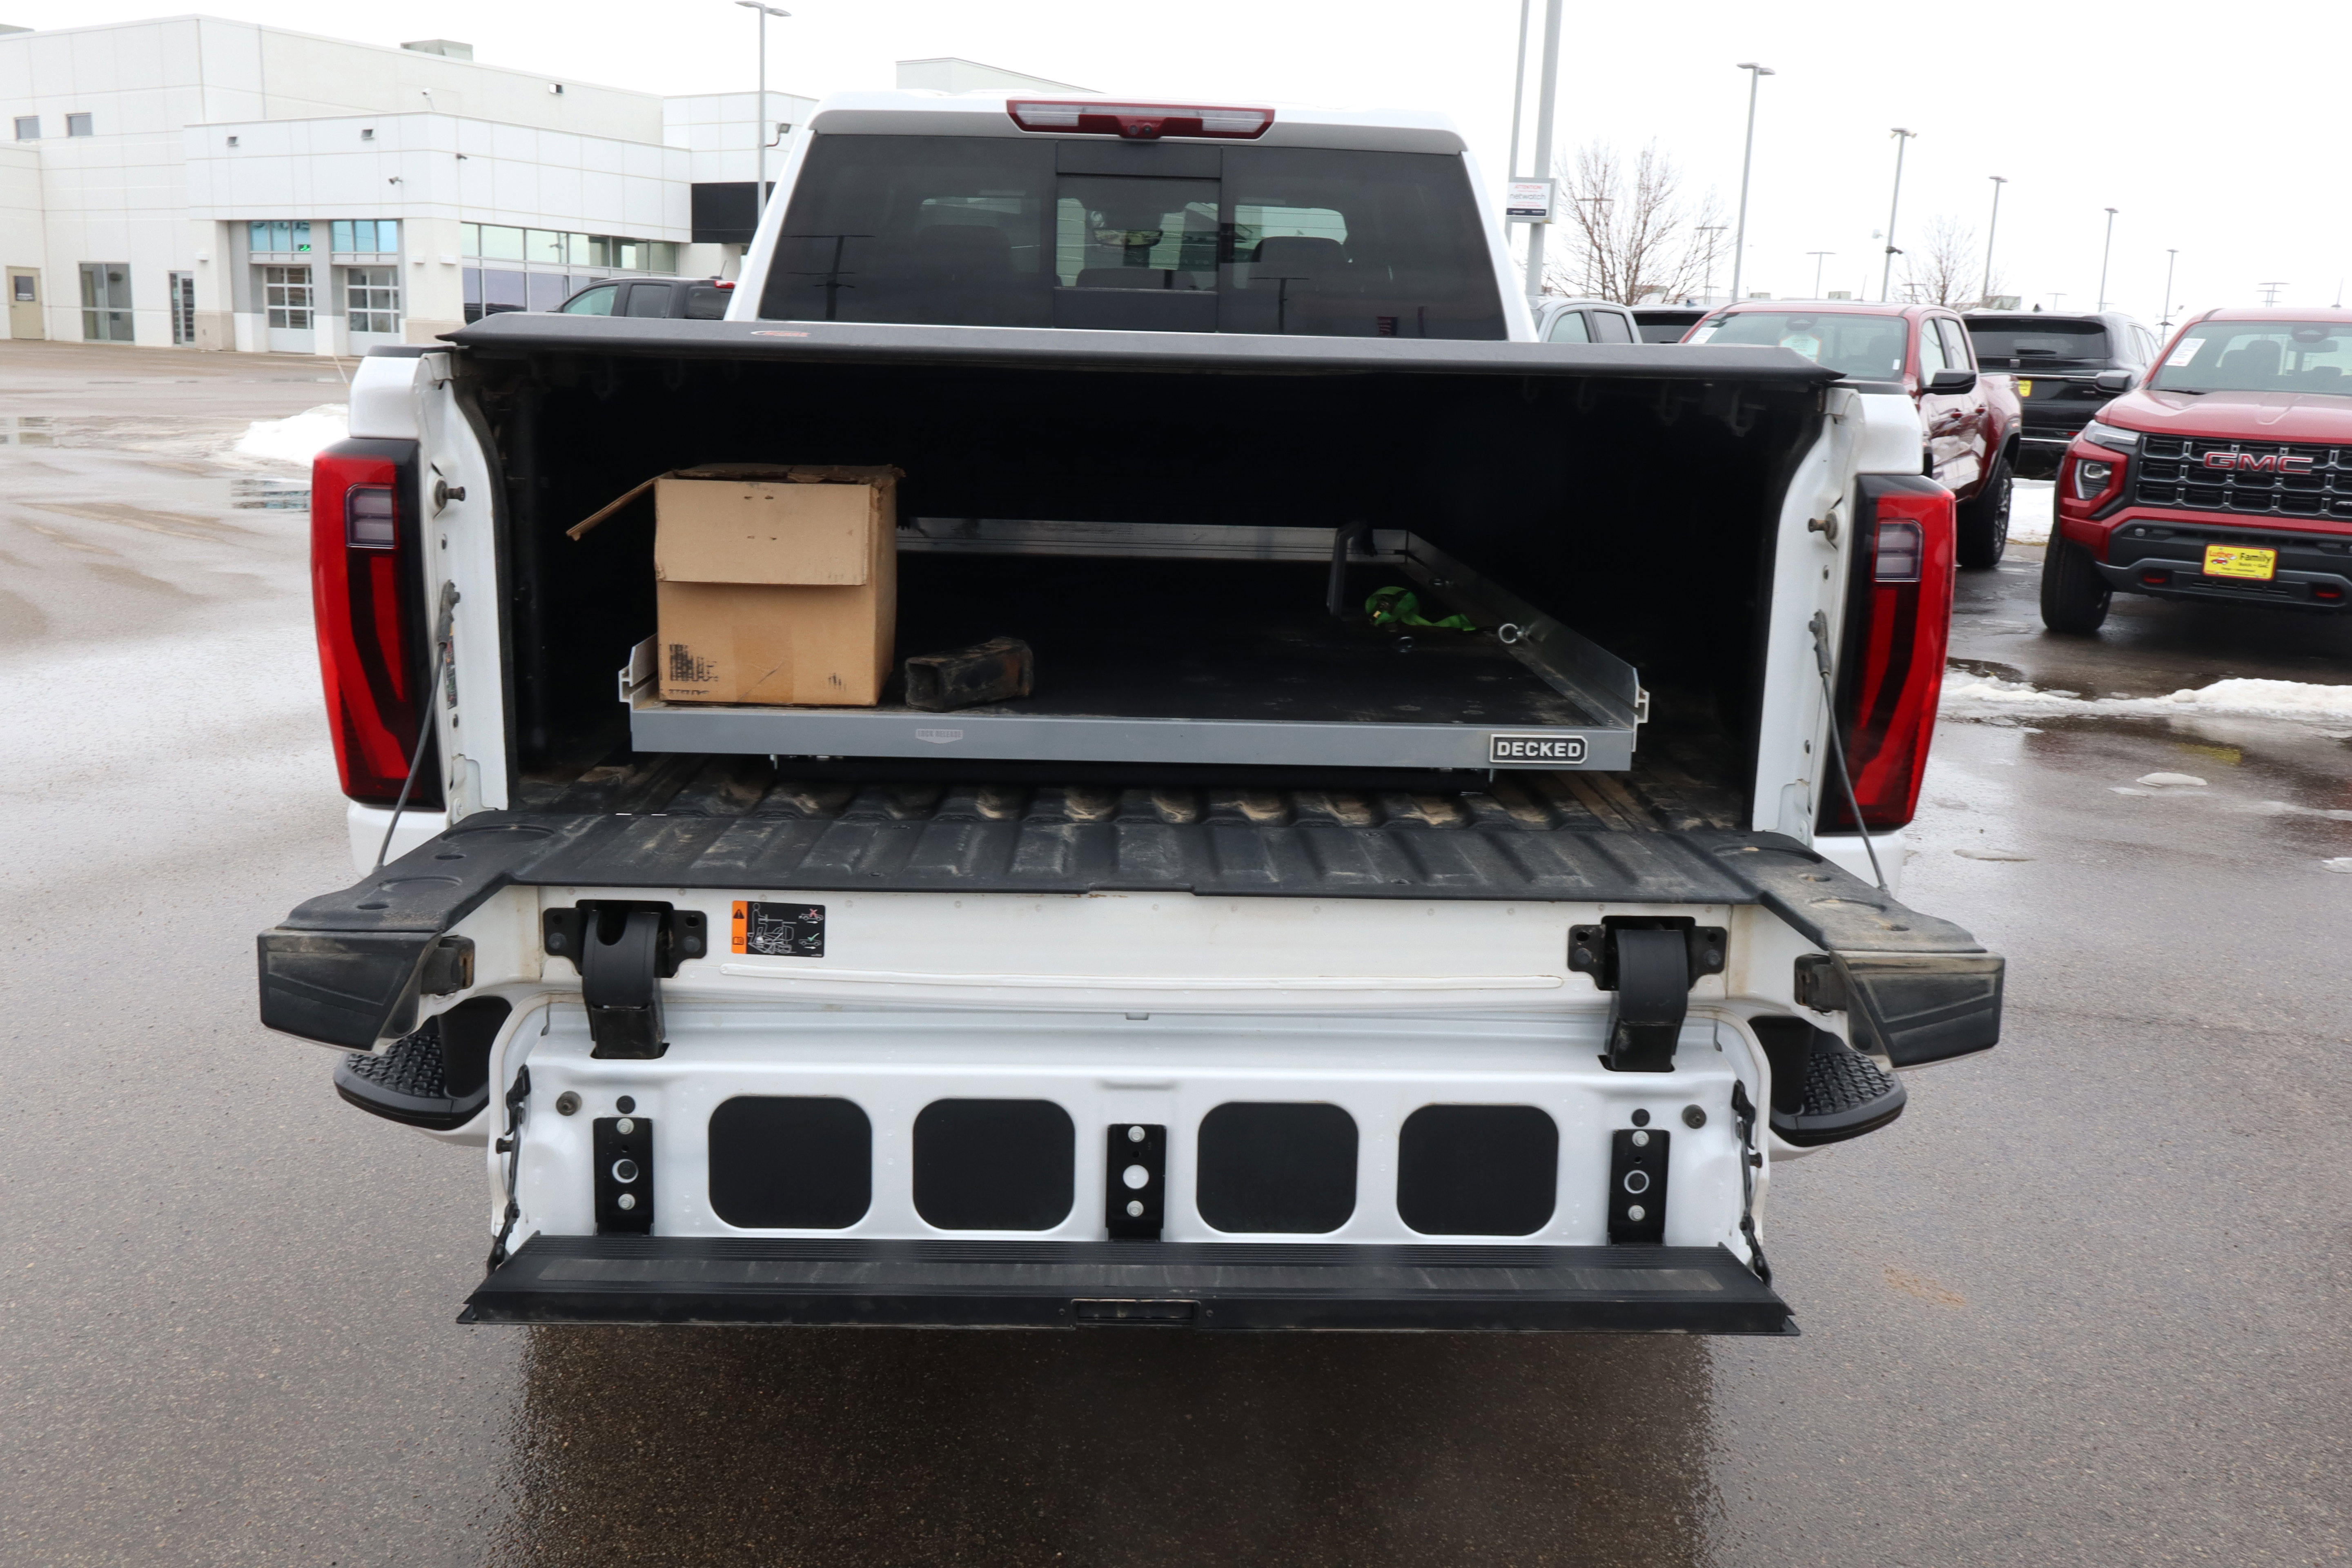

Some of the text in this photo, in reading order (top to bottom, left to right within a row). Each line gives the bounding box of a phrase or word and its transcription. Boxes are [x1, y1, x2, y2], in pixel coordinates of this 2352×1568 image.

[2203, 452, 2313, 474] GMC
[2240, 552, 2273, 564] Family
[1497, 742, 1581, 757] DECKED
